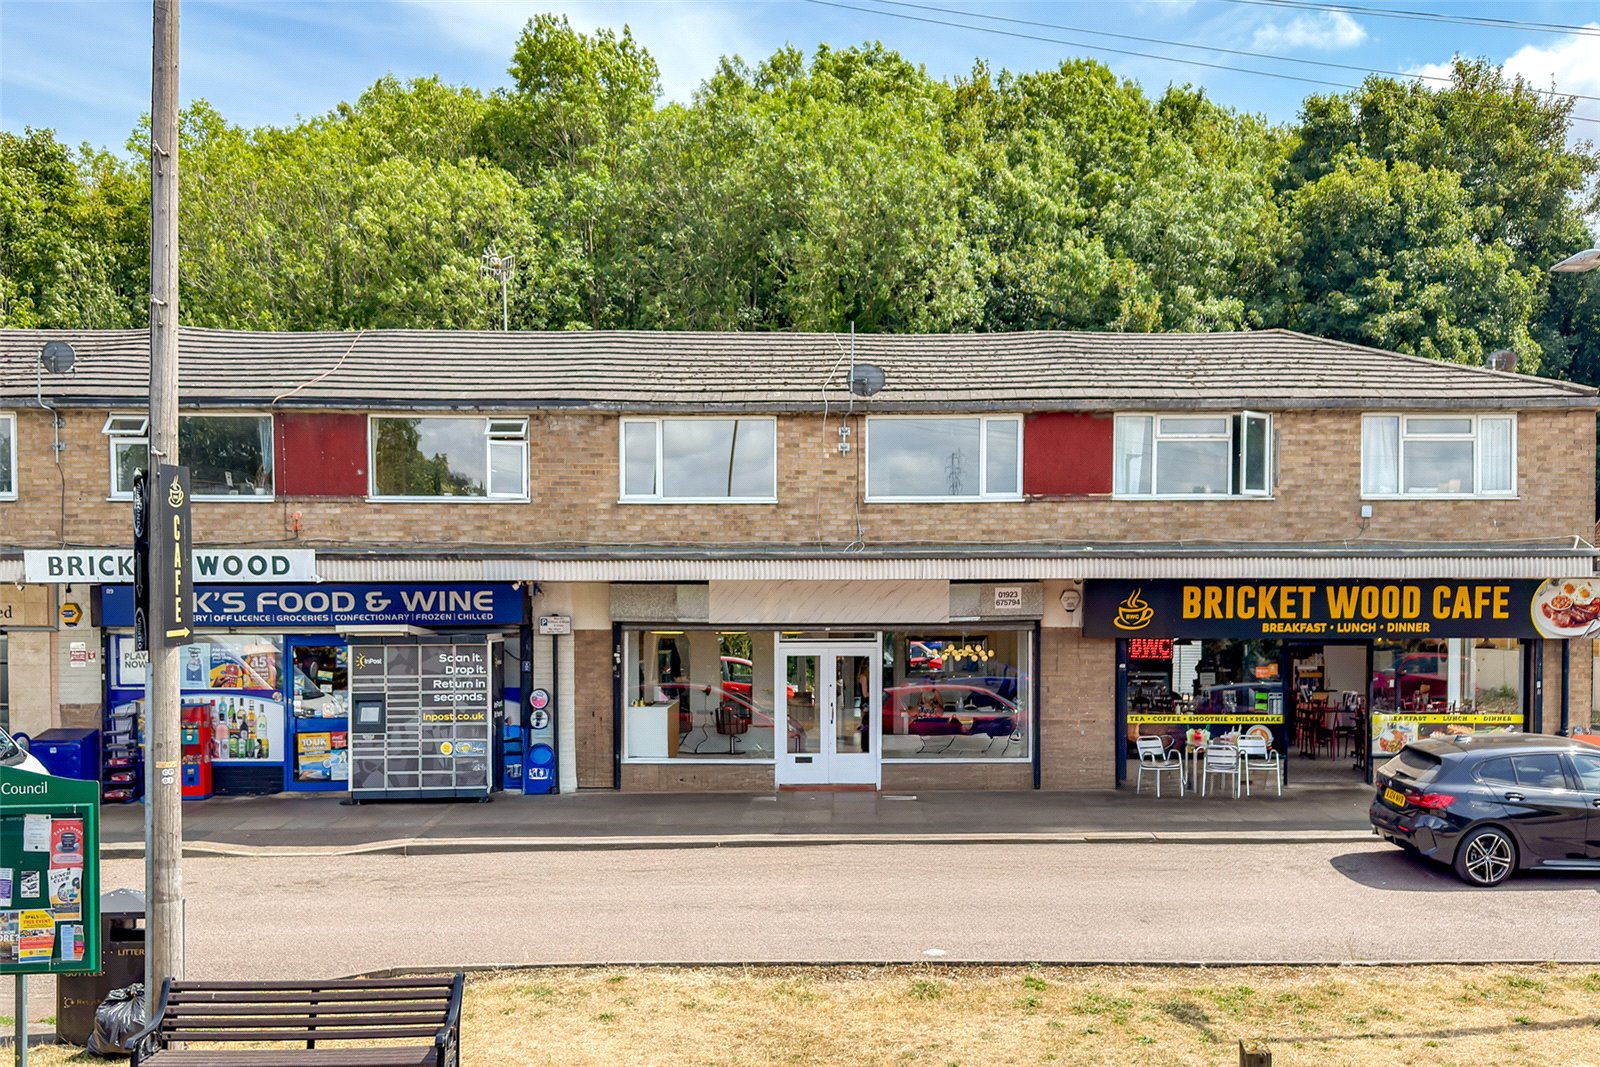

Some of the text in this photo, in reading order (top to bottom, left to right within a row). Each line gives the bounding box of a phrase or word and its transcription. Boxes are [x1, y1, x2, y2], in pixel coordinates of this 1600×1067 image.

[48, 556, 290, 576] BRICK WOOD
[173, 514, 182, 623] CAFE
[998, 591, 1018, 599] 01923
[192, 591, 493, 613] K'S FOOD & WINE
[1183, 586, 1510, 619] BRICKET WOOD CAFE
[214, 614, 233, 622] OFF
[234, 614, 271, 622] LICENCE
[276, 614, 329, 622] GROCERIES
[335, 614, 410, 622] CONFECTIONARY
[416, 613, 452, 621] FROZEN
[457, 613, 493, 621] CHILLED
[1262, 622, 1430, 633] BREAKFAST LUNCH DINNER
[1132, 639, 1170, 656] BWC
[124, 653, 147, 661] PLAY
[364, 658, 383, 666] InPost
[439, 653, 483, 663] Scan it.
[124, 661, 146, 669] NOW
[446, 665, 486, 676] Drop it.
[433, 680, 486, 689] Return in
[434, 693, 486, 702] seconds.
[1, 782, 48, 796] Council
